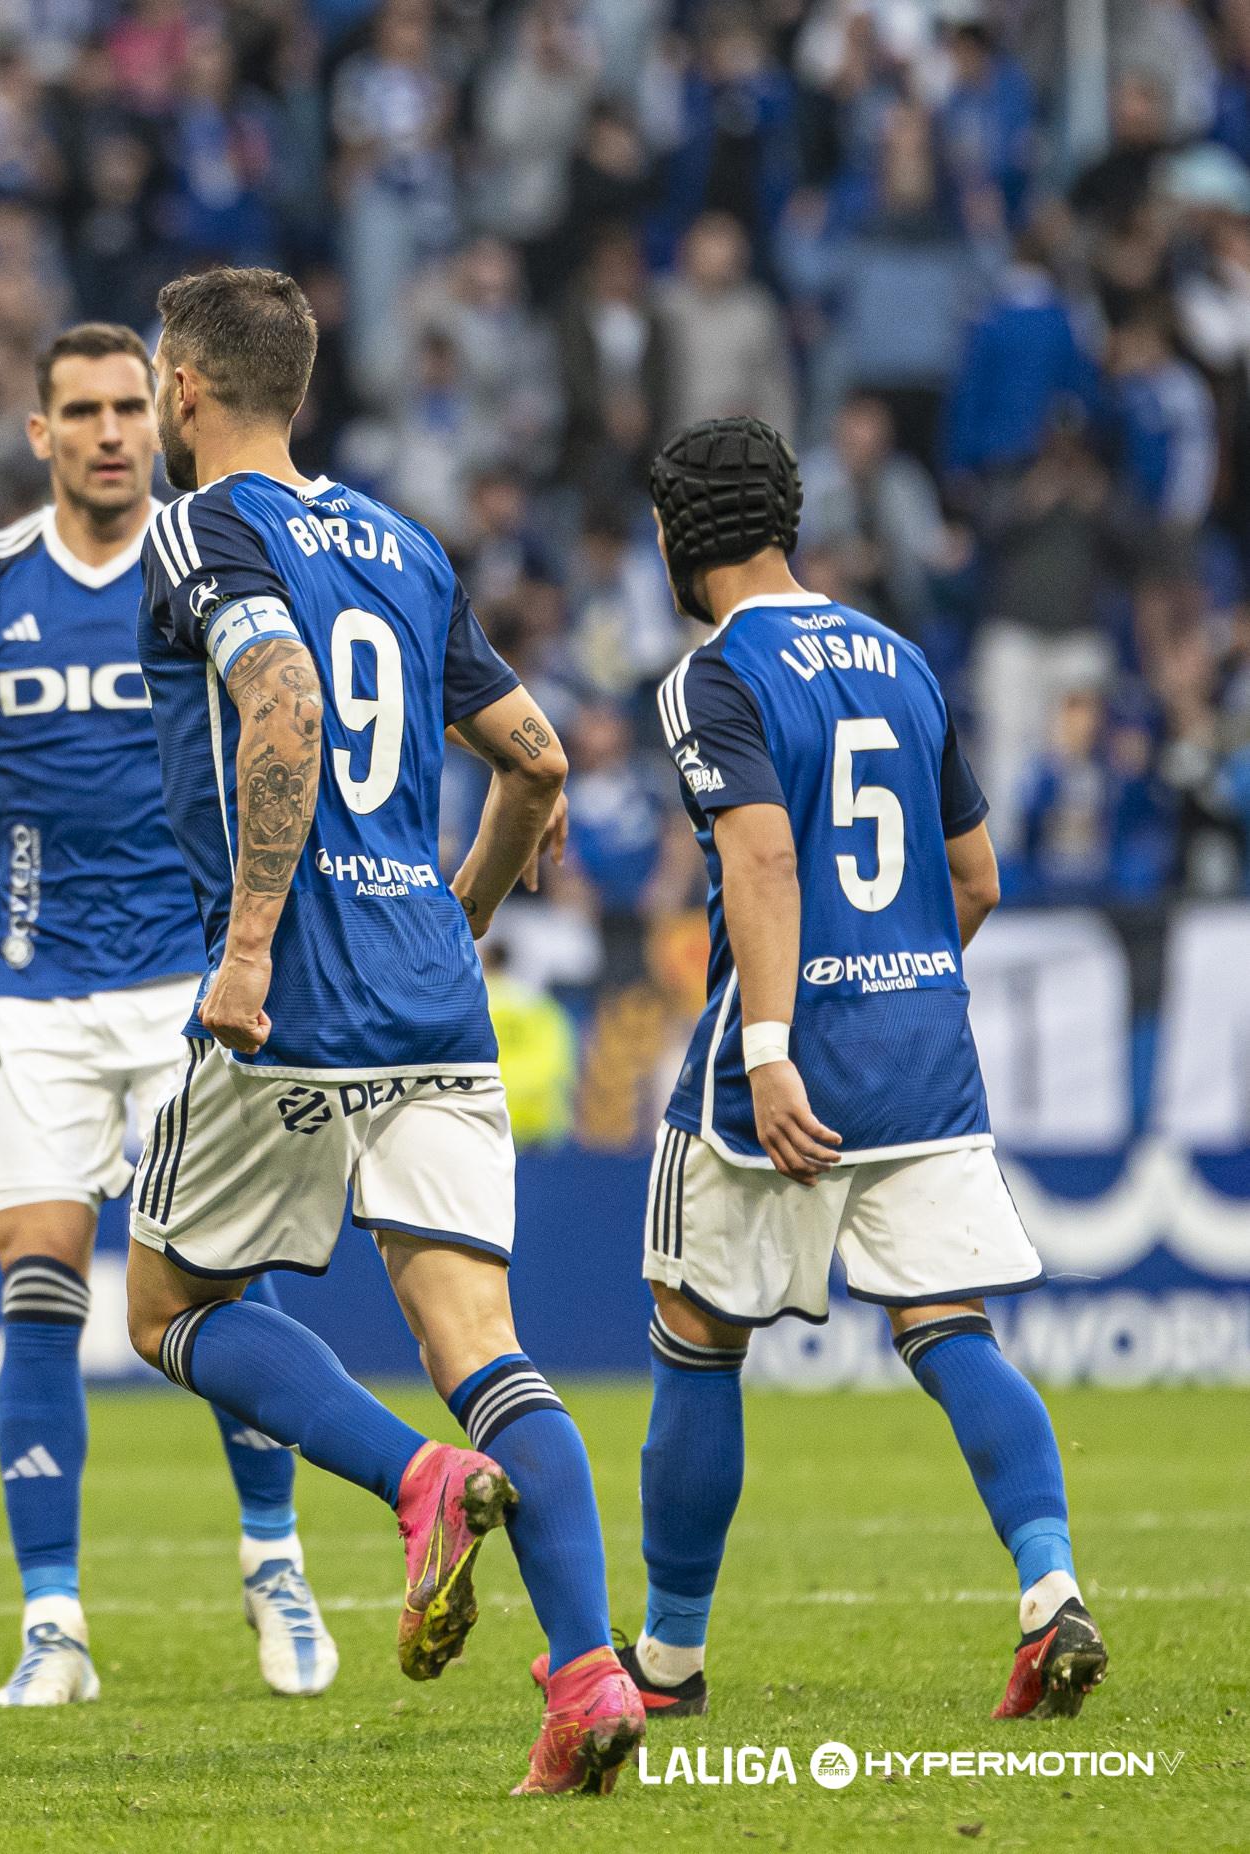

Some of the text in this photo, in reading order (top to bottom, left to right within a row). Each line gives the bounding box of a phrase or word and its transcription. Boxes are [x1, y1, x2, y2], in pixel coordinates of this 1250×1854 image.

[286, 514, 403, 572] BORJA
[780, 634, 896, 682] LUISMI
[331, 608, 404, 815] 9
[510, 717, 551, 760] 13
[832, 718, 905, 912] 5
[335, 855, 439, 887] HYUNDA
[356, 881, 410, 897] Asturdai
[846, 952, 956, 981] HYUNDA
[862, 975, 917, 994] Asturdai
